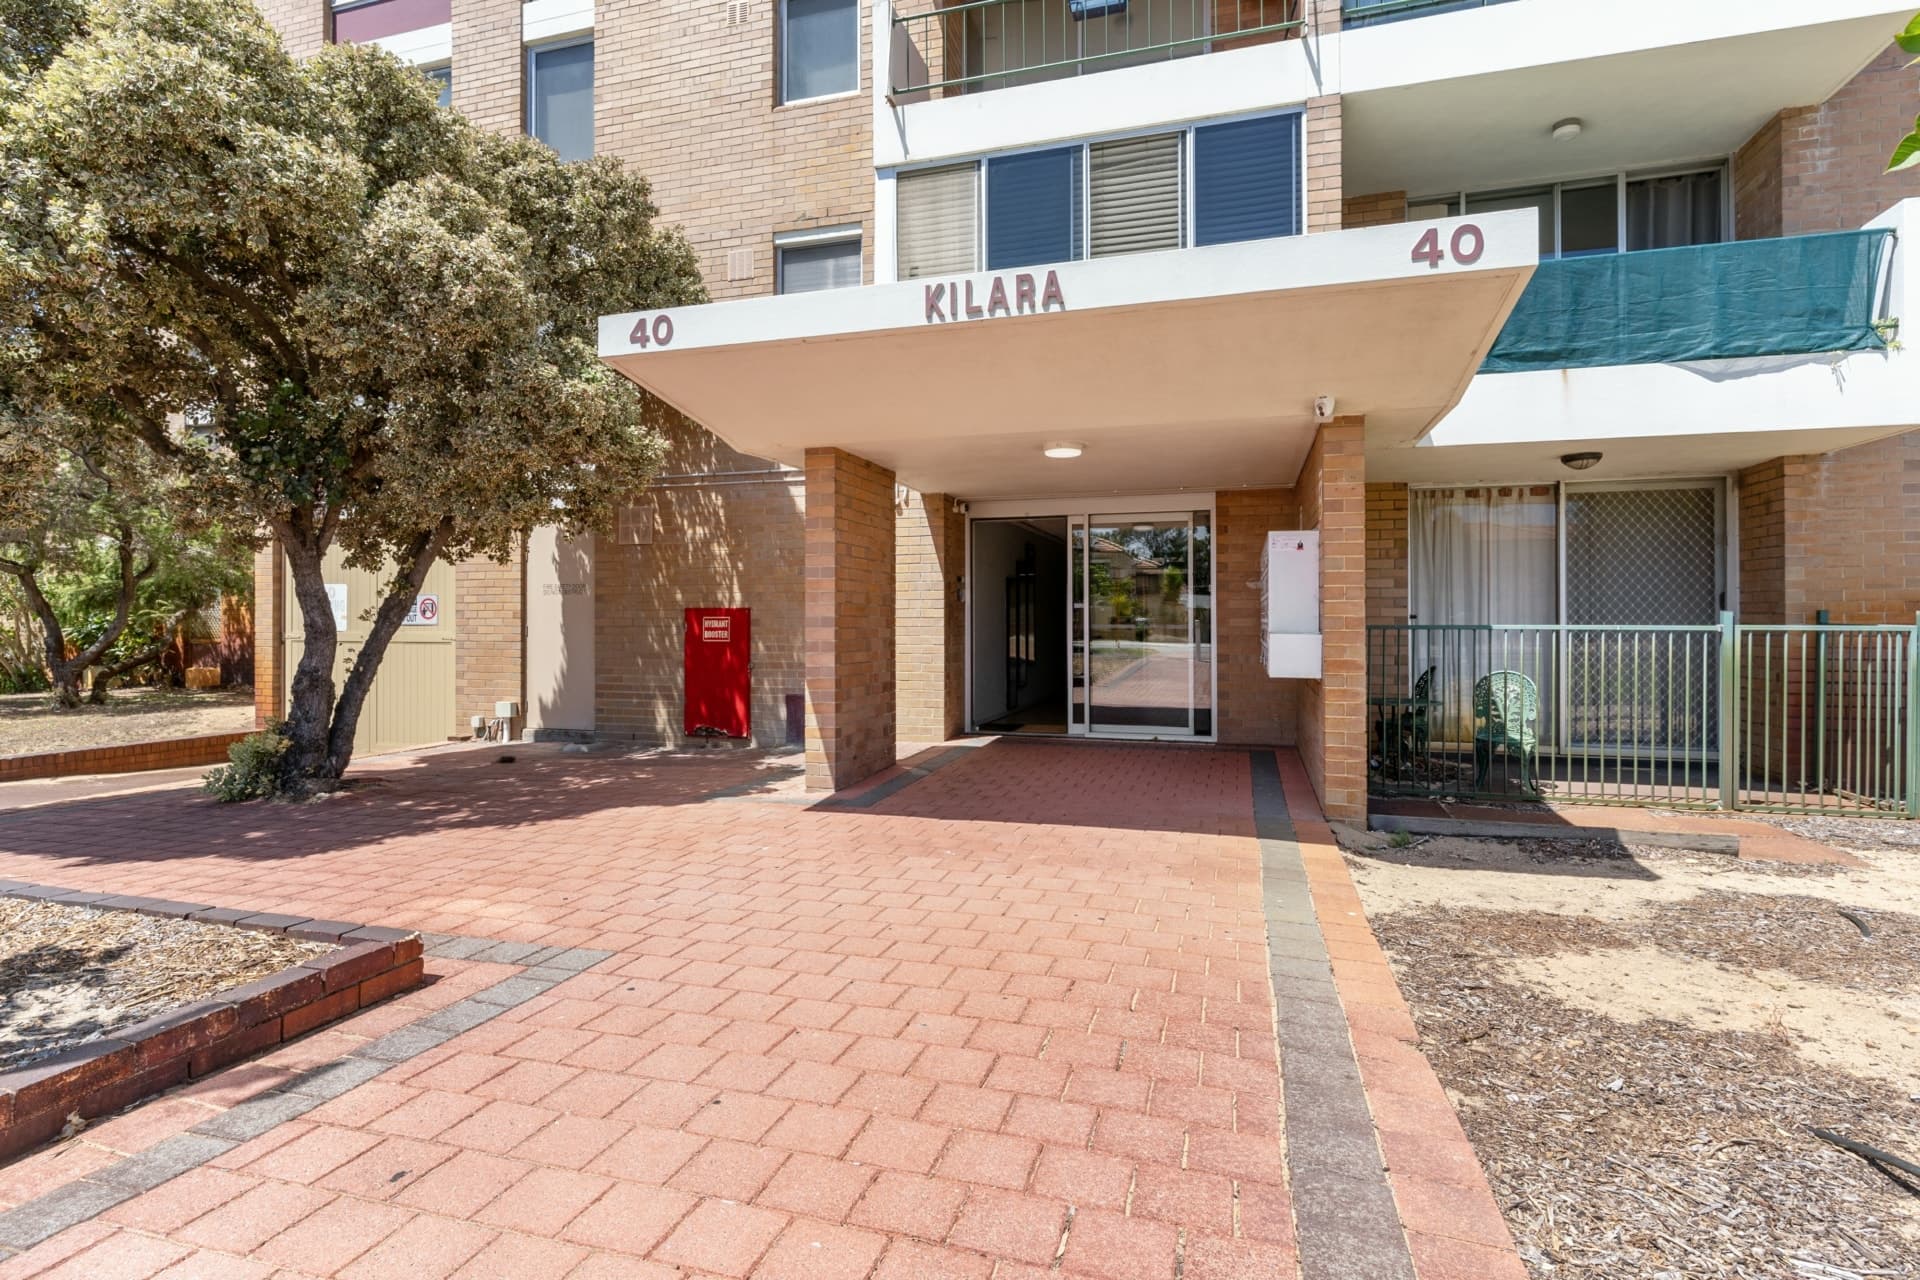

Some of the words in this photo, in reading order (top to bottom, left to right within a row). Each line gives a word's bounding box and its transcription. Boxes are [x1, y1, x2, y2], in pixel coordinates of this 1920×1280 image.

[1411, 223, 1485, 269] 40
[924, 269, 1066, 323] KILARA
[629, 314, 674, 349] 40
[704, 619, 728, 628] HYDRANT
[704, 630, 728, 639] BOOSTER
